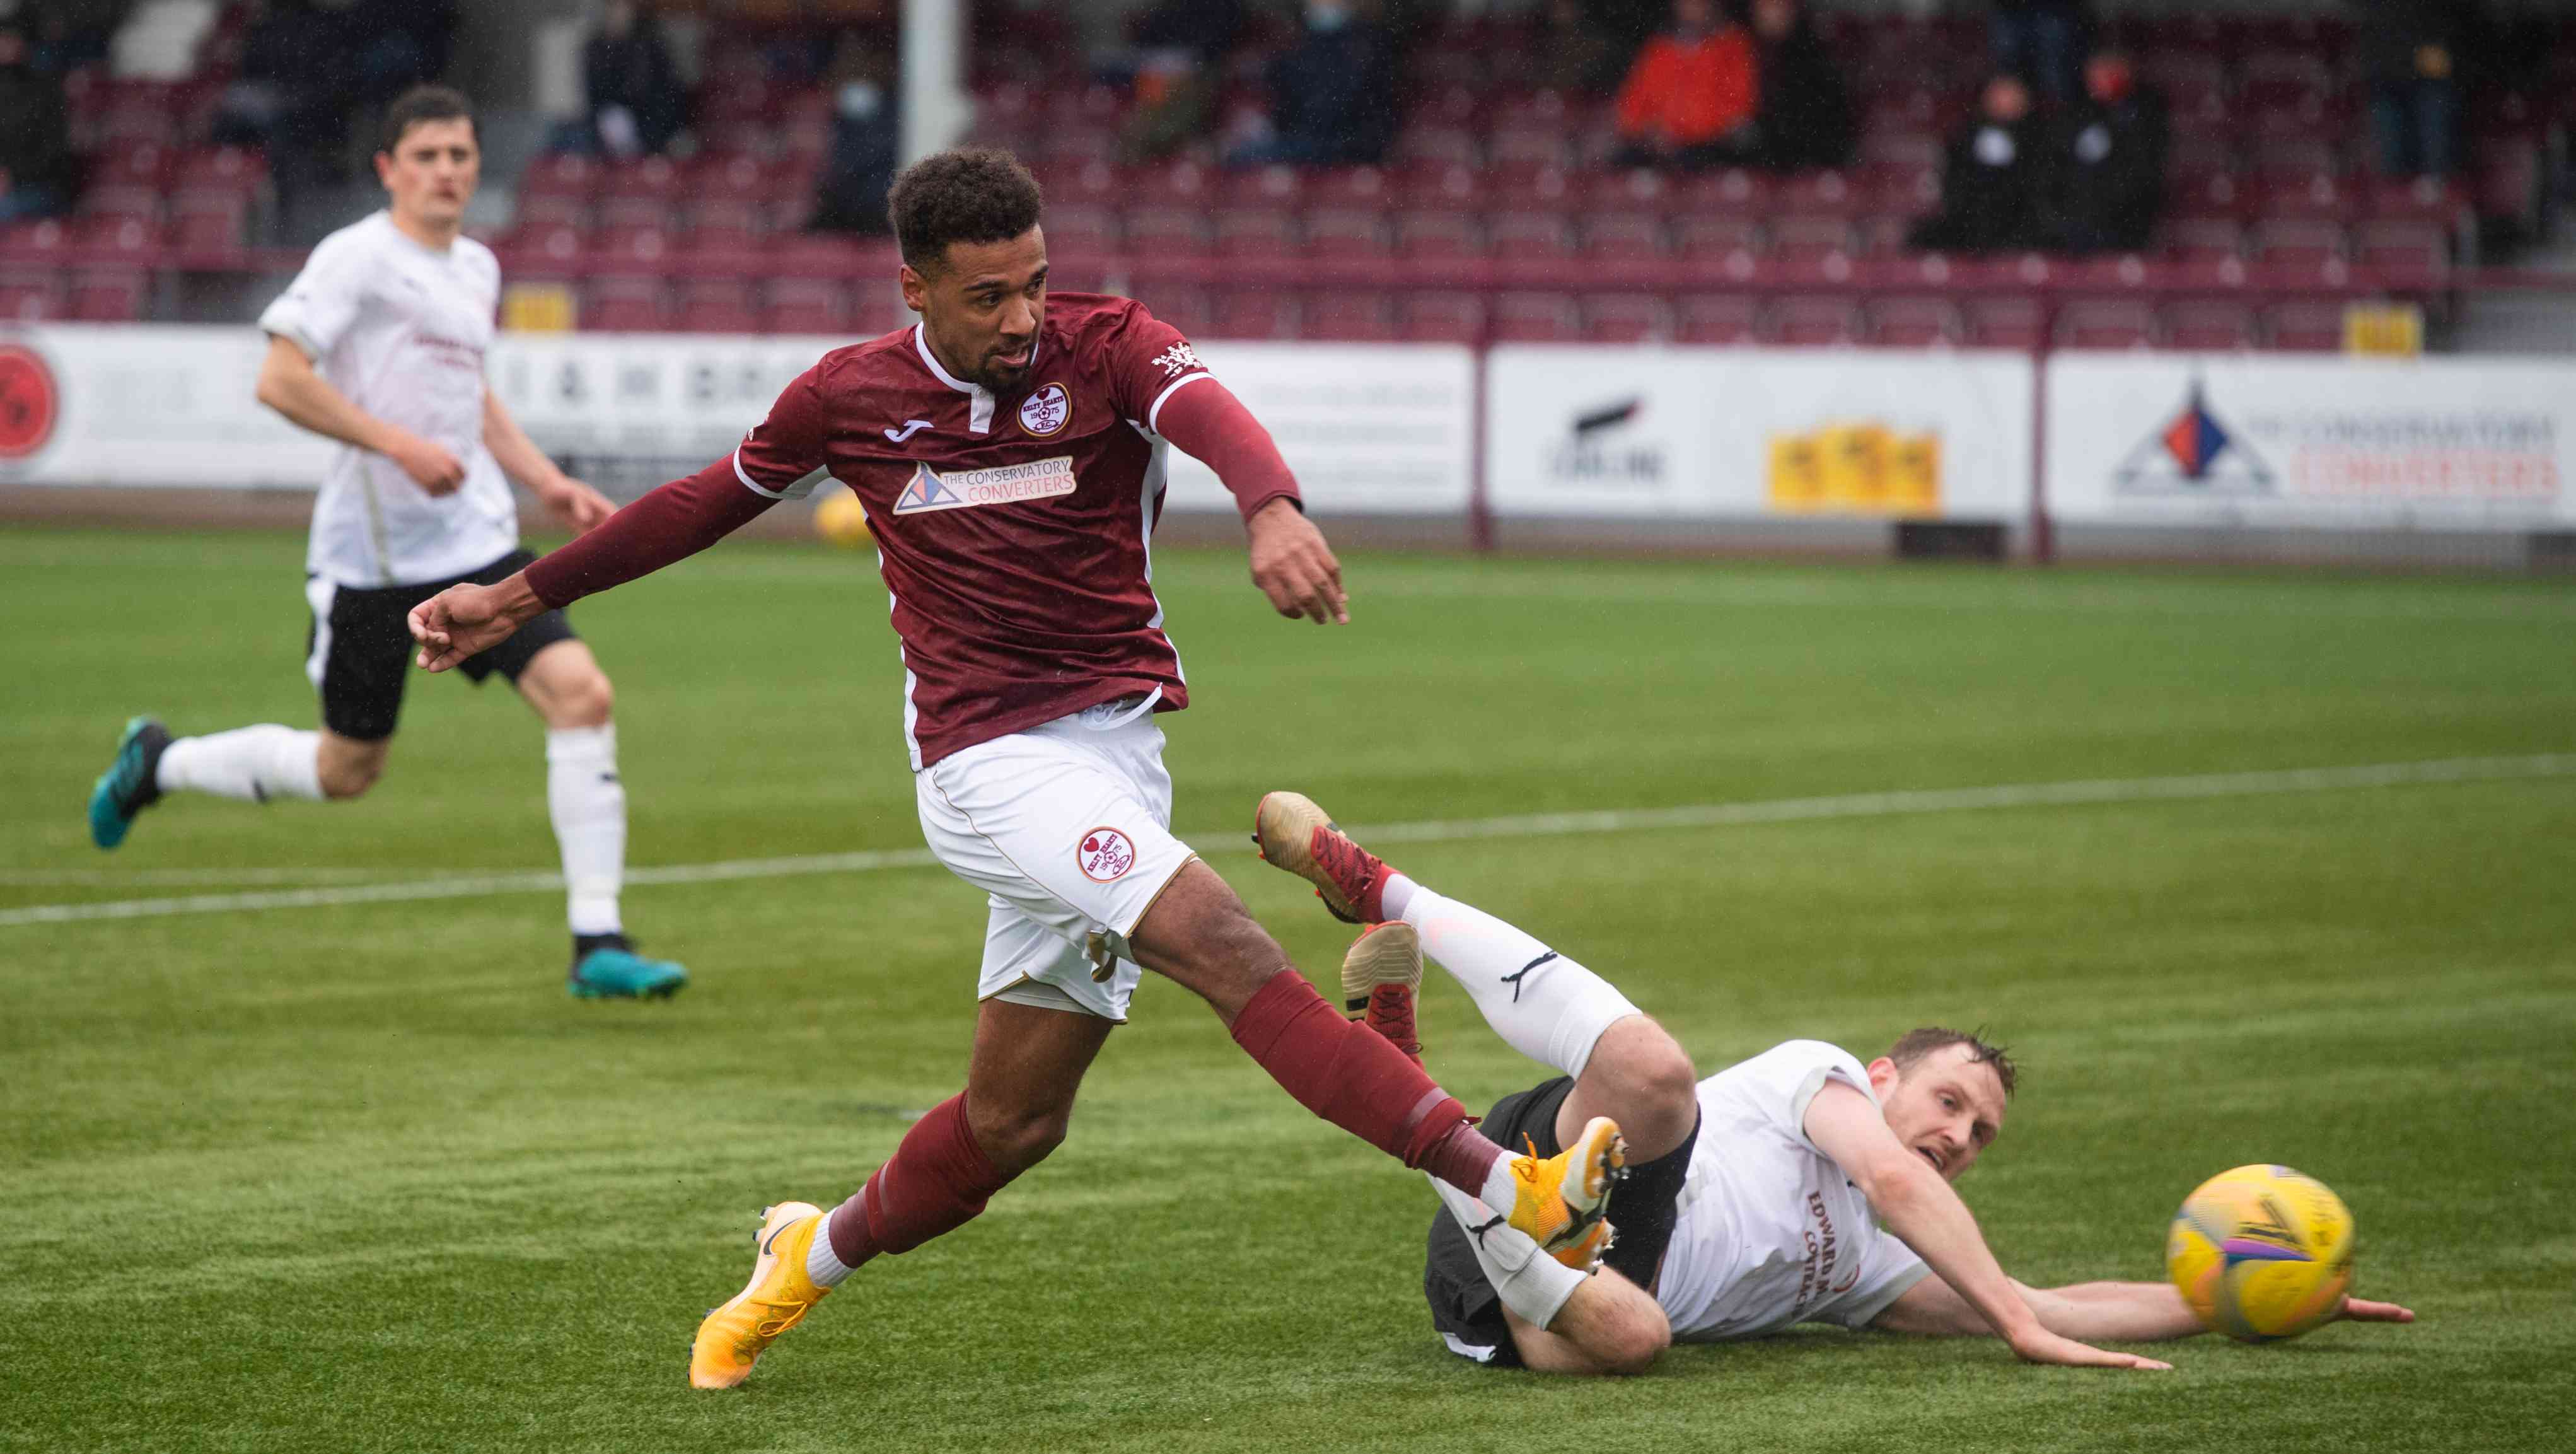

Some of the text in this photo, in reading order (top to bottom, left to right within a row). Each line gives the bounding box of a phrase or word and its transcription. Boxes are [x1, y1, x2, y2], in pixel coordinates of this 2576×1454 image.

[1023, 395, 1064, 412] KELTY HEARTS
[943, 459, 1069, 486] THE CONSERVATORY
[968, 474, 1073, 503] CONVERTERS
[2292, 451, 2560, 496] CONVERTERS
[1087, 834, 1117, 872] KELTY HEARTS
[1807, 1190, 1836, 1276] EDWARD
[1796, 1230, 1818, 1309] CONTRAC
